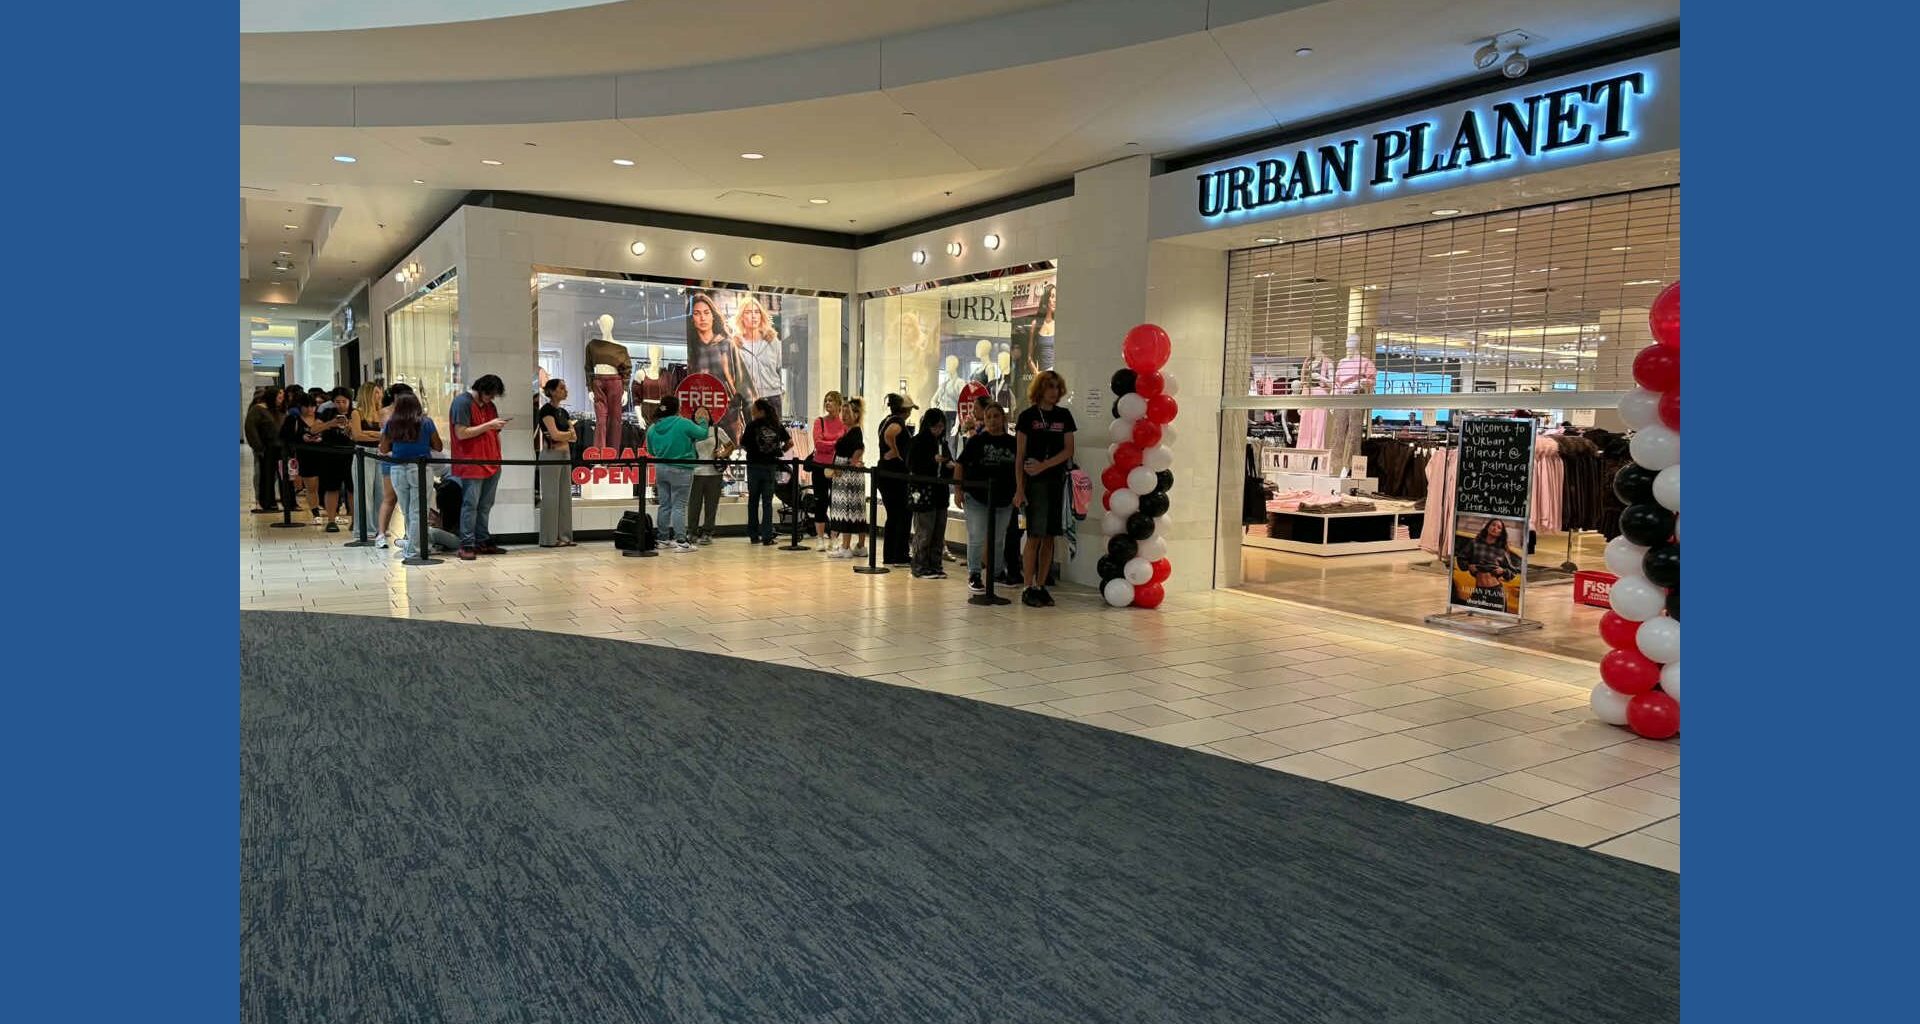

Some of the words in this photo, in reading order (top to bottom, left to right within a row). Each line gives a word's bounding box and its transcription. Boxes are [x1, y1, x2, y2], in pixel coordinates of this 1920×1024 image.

[1197, 139, 1360, 217] URBAN
[1370, 72, 1645, 186] PLANET
[947, 296, 1010, 322] URBA
[1384, 380, 1433, 395] PLANET
[678, 391, 725, 408] FREE
[1465, 422, 1511, 435] Welcome
[1515, 423, 1525, 436] to
[1466, 446, 1505, 459] Planet
[1508, 447, 1521, 459] @
